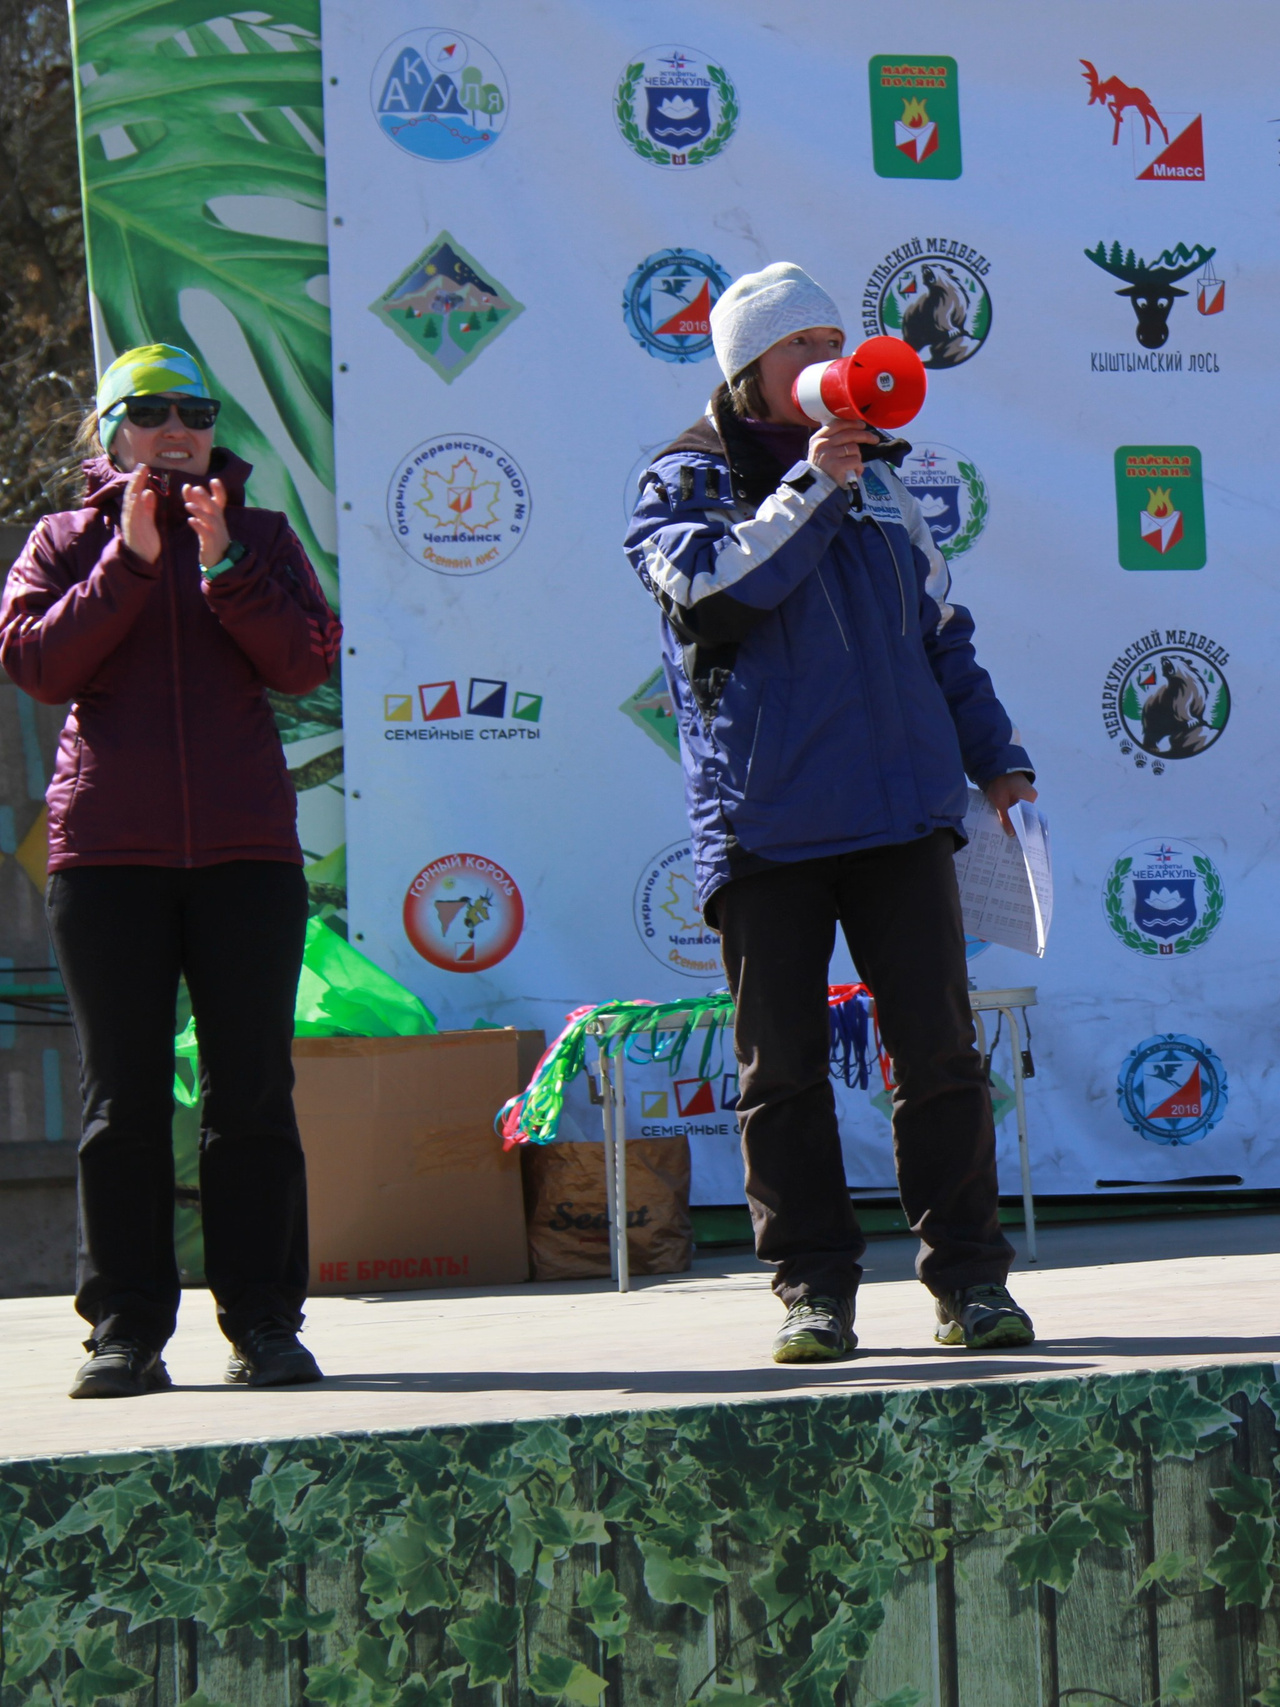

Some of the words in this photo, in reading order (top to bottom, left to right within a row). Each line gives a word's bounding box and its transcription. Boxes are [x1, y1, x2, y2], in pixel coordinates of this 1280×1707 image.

[881, 63, 947, 76] МАЙСКАЯ
[644, 76, 711, 87] ЧЕБАРКУЛЬ
[881, 77, 947, 88] ПОЛЯНА
[1153, 163, 1203, 178] Миасс
[862, 236, 923, 338] ЕБАРКУЛЬСКИЙ
[926, 238, 991, 276] МЕДВЕДЬ
[679, 321, 708, 332] 2016
[1091, 351, 1182, 373] КЫШТЫМСКИЙ
[414, 441, 494, 466] первенство
[1126, 454, 1191, 466] МАЙСКАЯ
[496, 457, 525, 498] СШОР
[1126, 467, 1191, 478] ПОЛЯНА
[395, 467, 414, 535] Открытое
[510, 525, 521, 534] 5
[423, 532, 502, 543] Челябинск
[1102, 629, 1163, 739] ЧЕБАРКУЛЬСКИЙ
[1166, 630, 1230, 667] МЕДВЕДЬ
[384, 726, 474, 741] СЕМЕЙНЫЕ
[479, 728, 540, 740] СТАРТЫ
[410, 854, 462, 898] ГОРНЫЙ
[465, 856, 515, 896] КОРОЛЬ
[1133, 870, 1197, 879] ЧЕБАРКУЛЬ
[642, 870, 660, 938] Открытое
[669, 934, 721, 945] Челяби
[1171, 1104, 1199, 1115] 2016
[641, 1122, 728, 1136] СЕМЕЙНЫЕ
[319, 1261, 349, 1283] НЕ
[357, 1255, 469, 1281] БРОСАТЬ!
